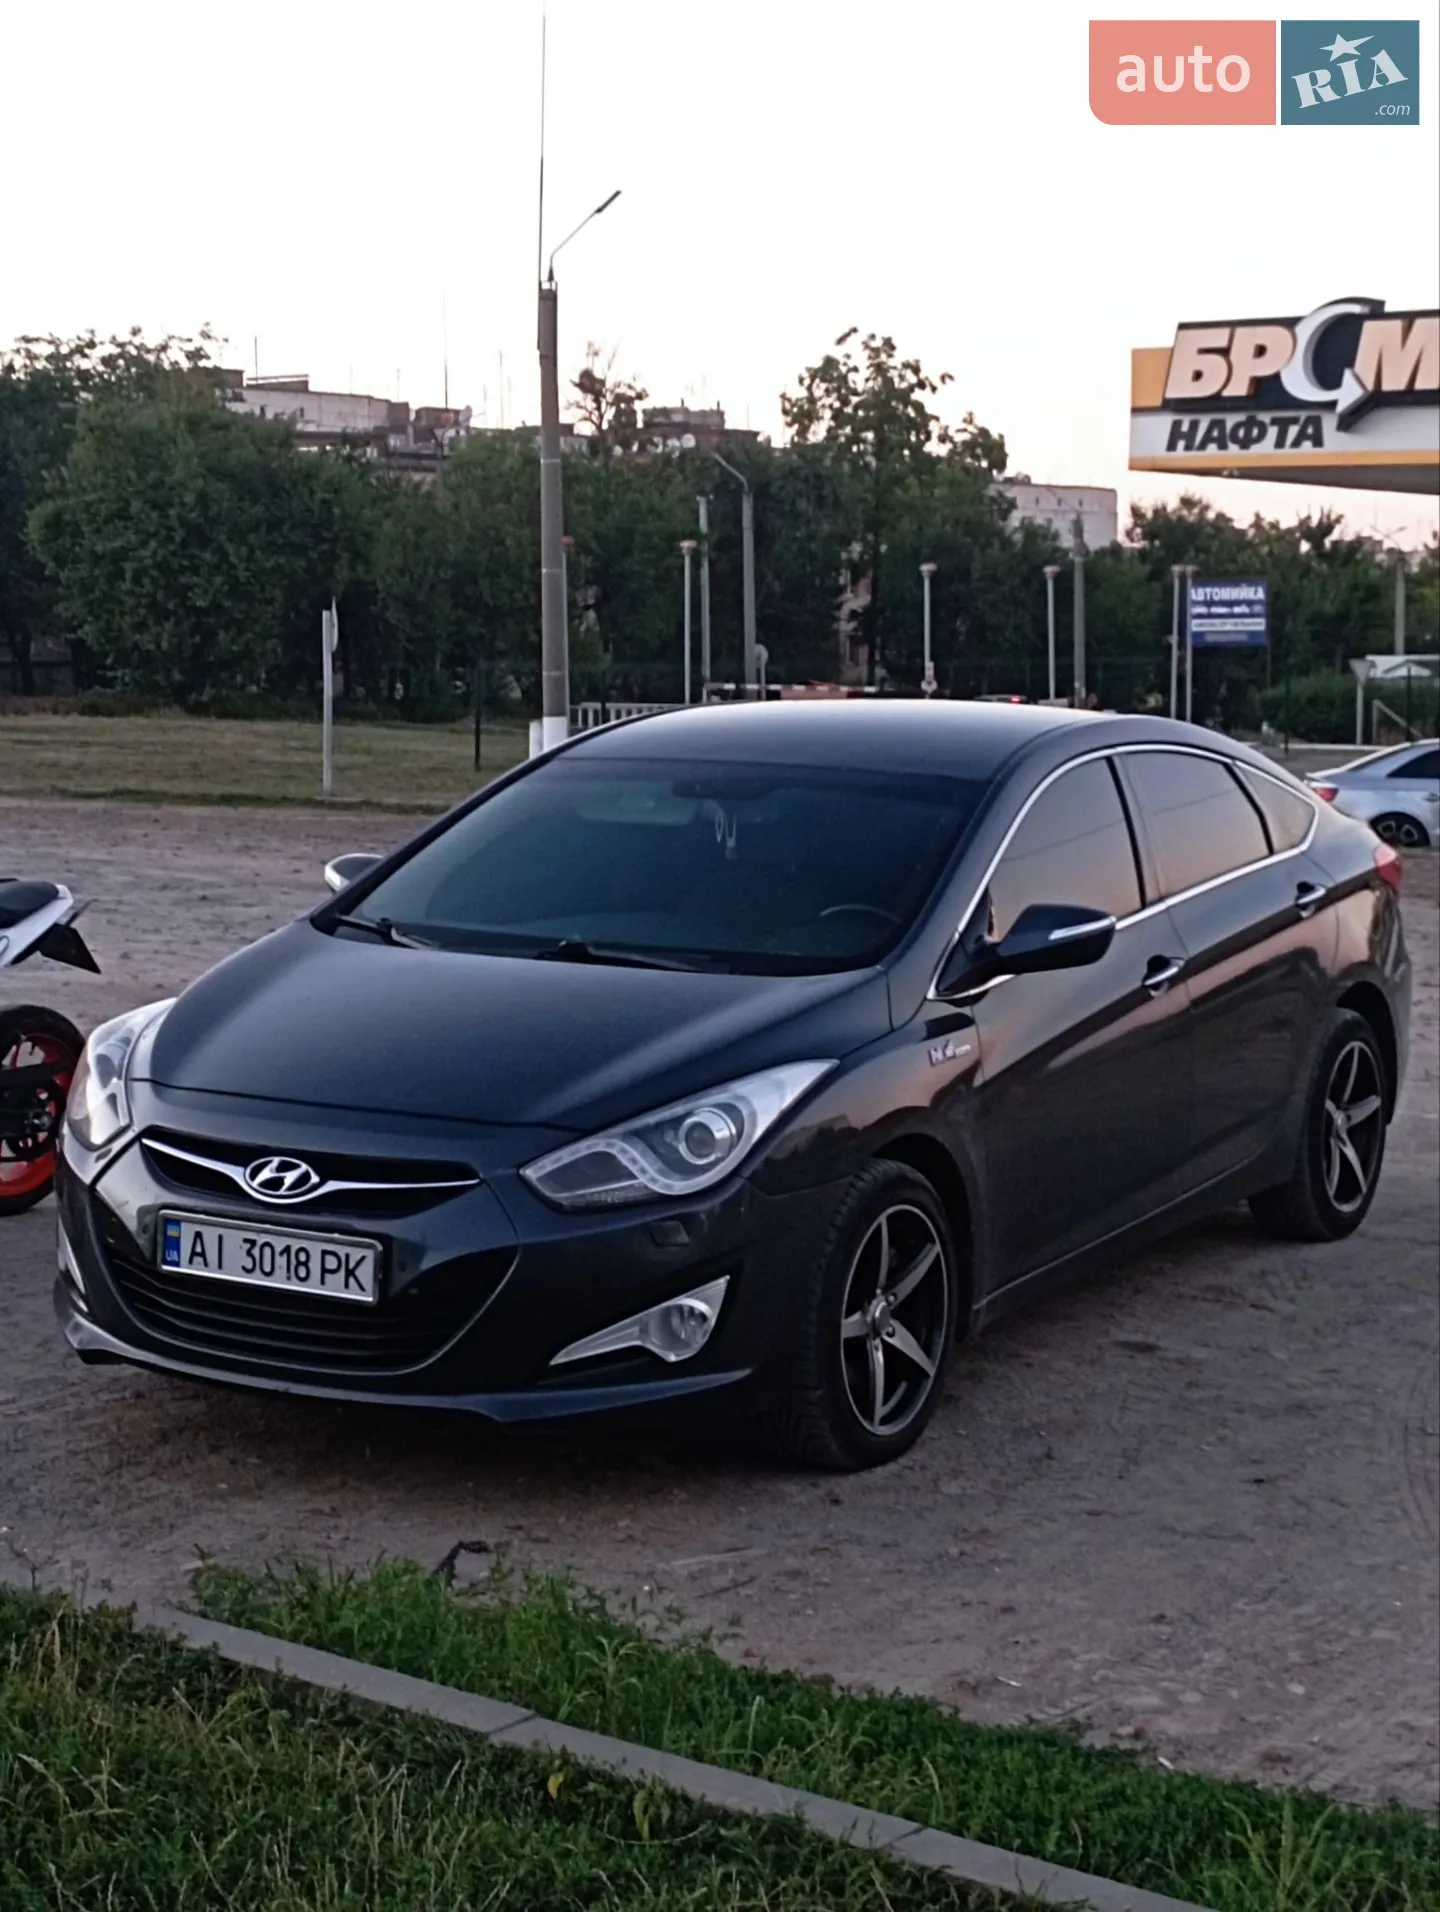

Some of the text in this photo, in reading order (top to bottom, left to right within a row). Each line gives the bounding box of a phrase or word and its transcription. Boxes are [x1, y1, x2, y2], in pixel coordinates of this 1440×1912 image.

[1164, 300, 1440, 413] БРСМ
[1165, 414, 1325, 452] НАФТА
[165, 1250, 179, 1262] UA
[241, 1237, 311, 1284] 3018
